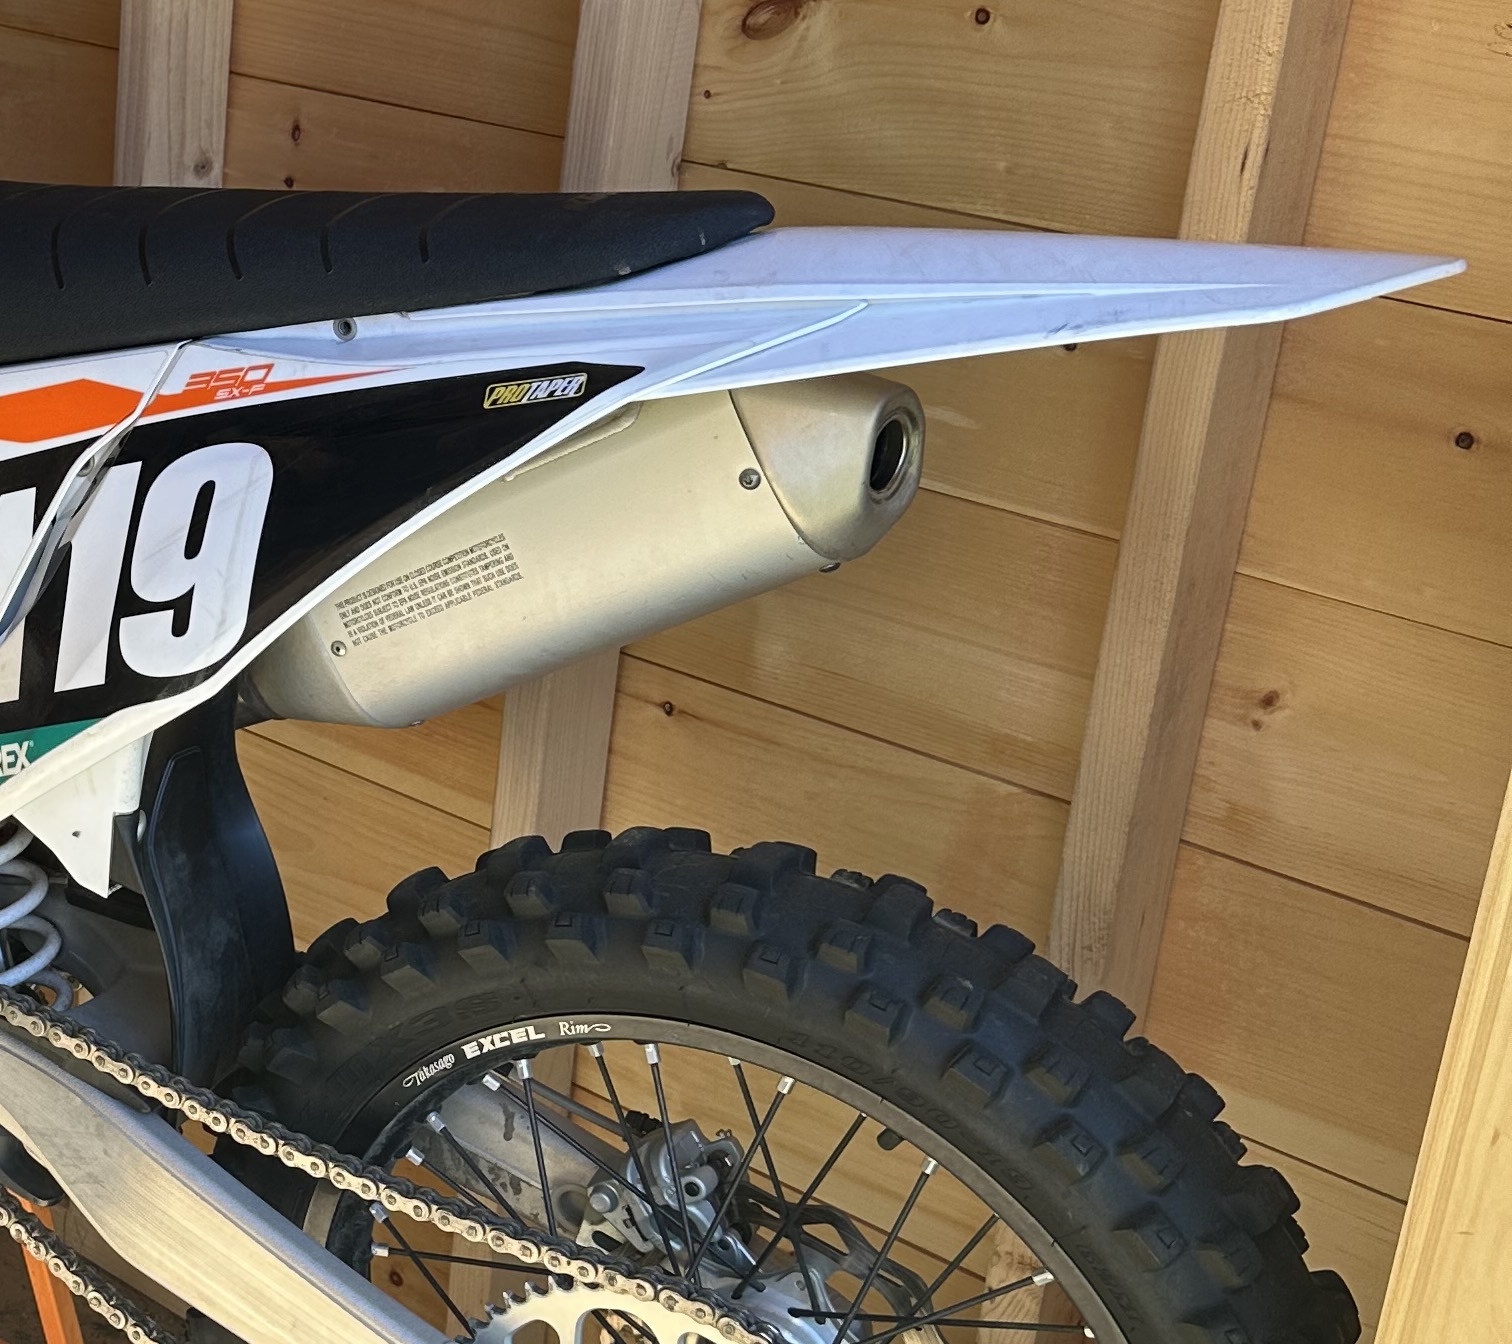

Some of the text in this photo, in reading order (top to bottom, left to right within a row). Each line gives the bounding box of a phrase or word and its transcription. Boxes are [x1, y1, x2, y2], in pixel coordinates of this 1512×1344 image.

[185, 363, 274, 390] 350
[214, 384, 266, 400] SX-F
[461, 1025, 546, 1060] EXCEL
[559, 1020, 612, 1037] Rim
